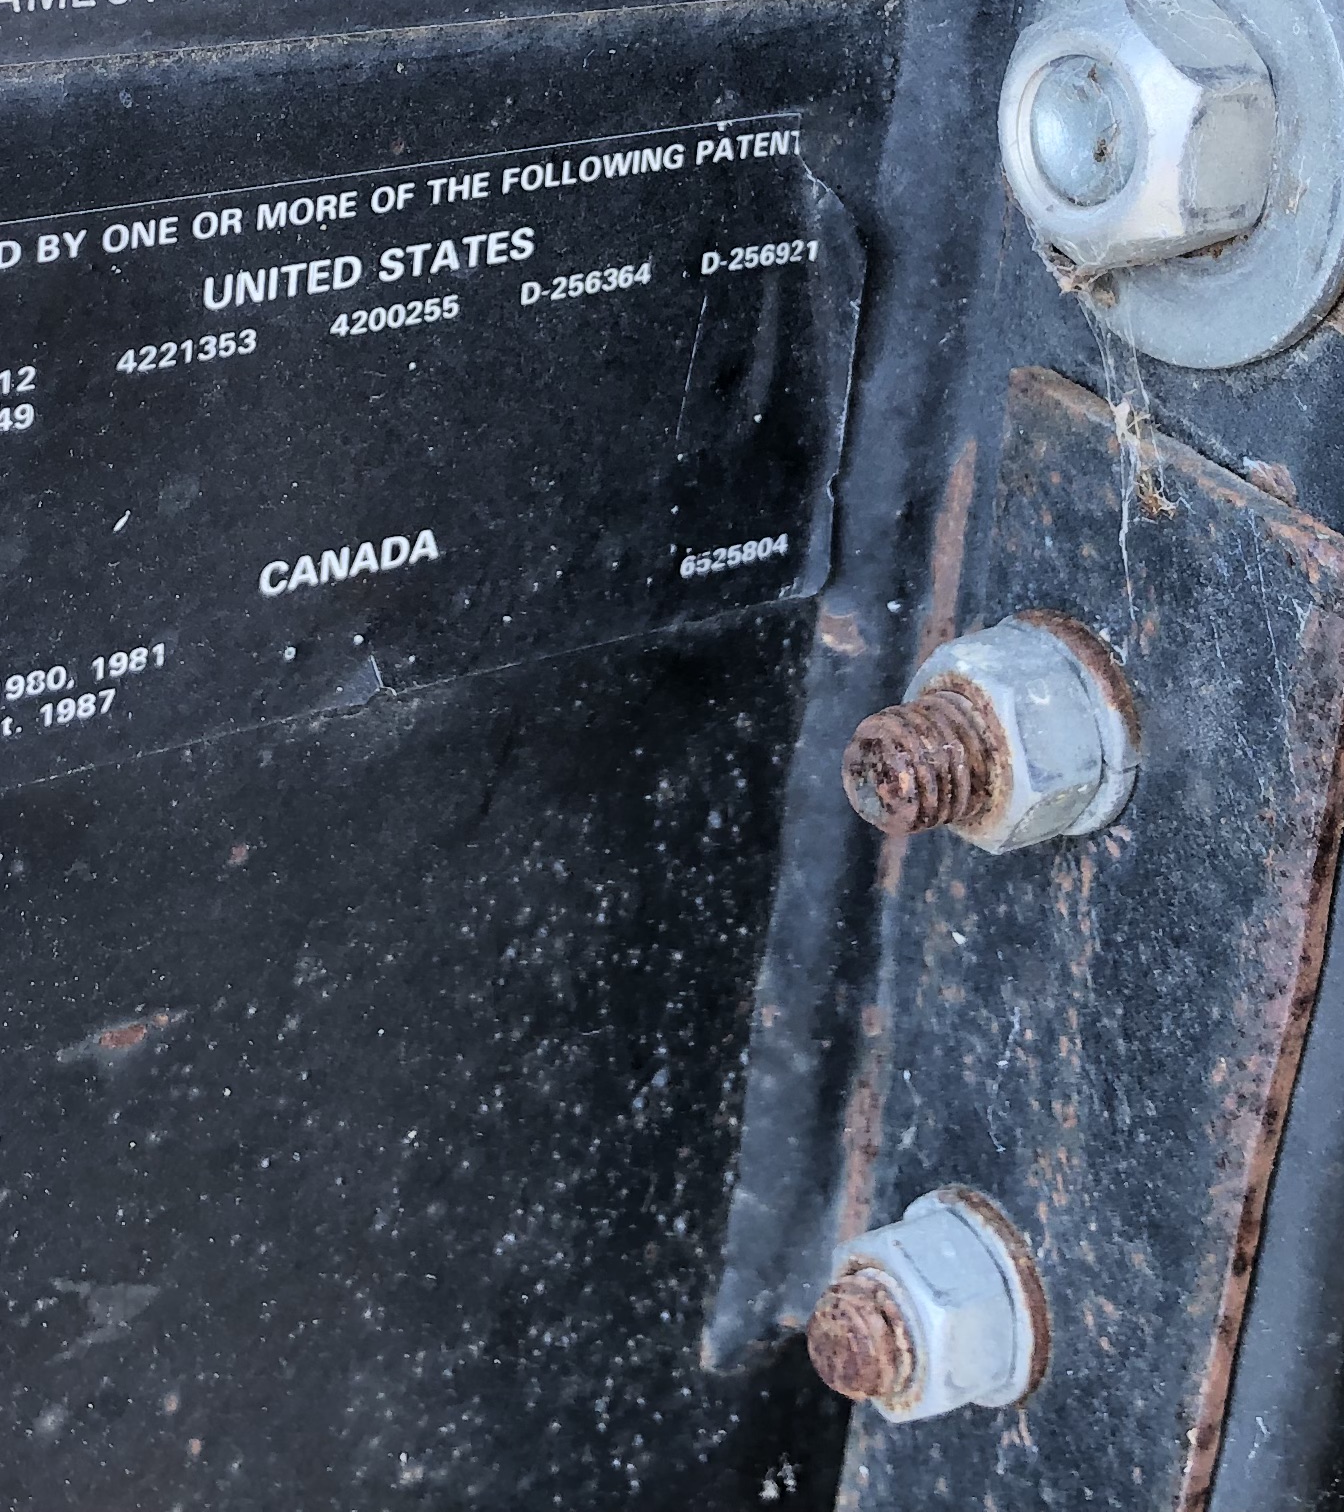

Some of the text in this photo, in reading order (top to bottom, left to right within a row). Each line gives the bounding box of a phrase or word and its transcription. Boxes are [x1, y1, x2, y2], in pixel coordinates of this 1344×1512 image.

[36, 229, 87, 263] BY
[102, 216, 179, 253] ONE
[192, 207, 243, 240] OR
[256, 190, 358, 231] MORE
[370, 182, 416, 214] OF
[426, 171, 491, 205] THE
[501, 143, 685, 195] FOLLOWING
[203, 227, 536, 312] UNITED STATES
[116, 328, 257, 375] 4221353
[329, 294, 460, 337] 4200255
[520, 261, 652, 307] D-256364
[700, 239, 818, 275] D-256921
[258, 529, 439, 597] CANADA
[679, 533, 789, 579] 6525804
[92, 642, 165, 681] 1981
[38, 688, 116, 728] 1987
